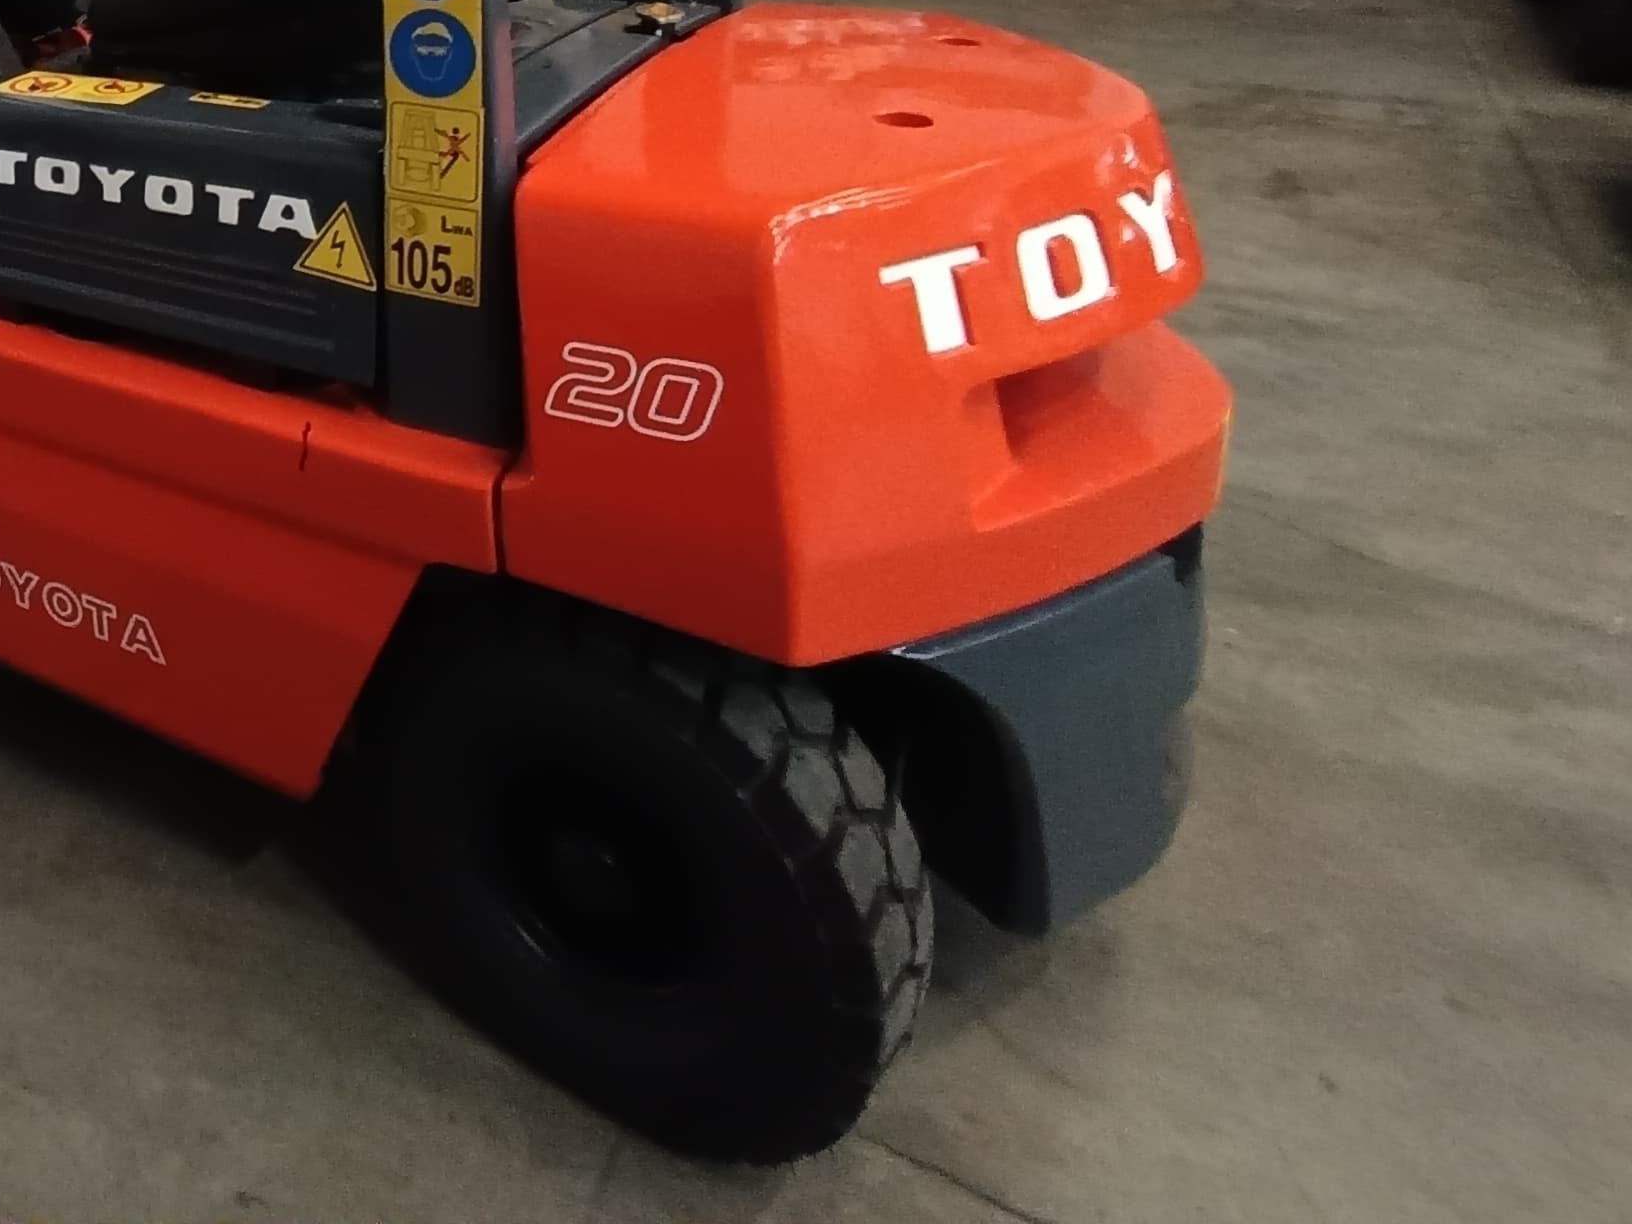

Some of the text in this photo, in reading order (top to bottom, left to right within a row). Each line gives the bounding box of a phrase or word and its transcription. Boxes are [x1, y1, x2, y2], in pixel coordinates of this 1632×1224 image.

[391, 237, 474, 297] 105 dB
[545, 342, 724, 441] 20
